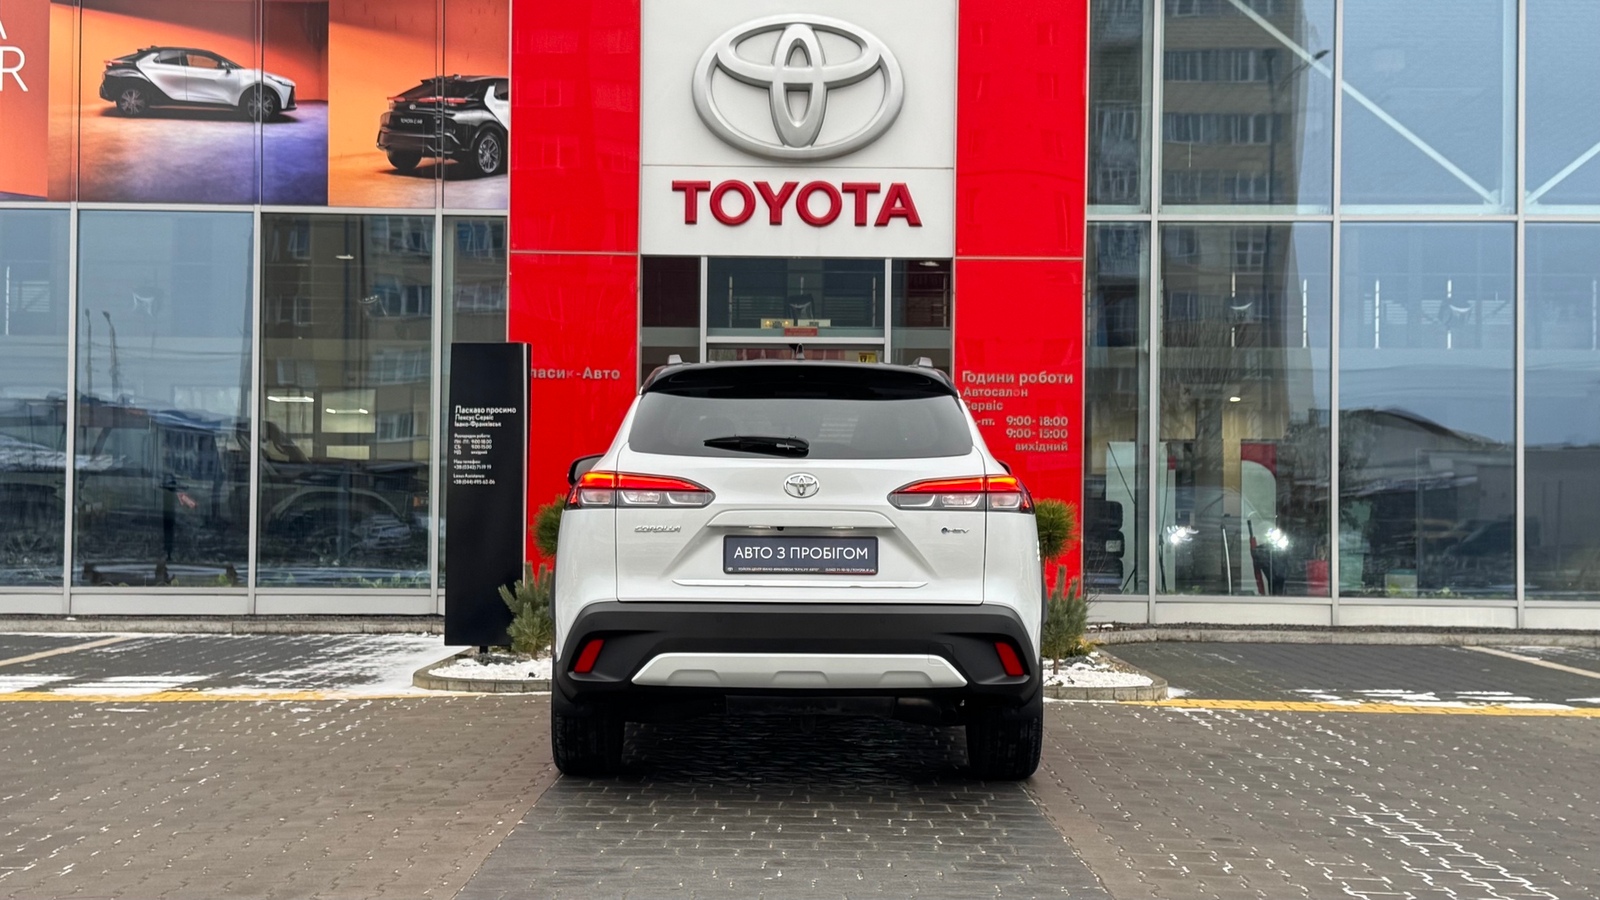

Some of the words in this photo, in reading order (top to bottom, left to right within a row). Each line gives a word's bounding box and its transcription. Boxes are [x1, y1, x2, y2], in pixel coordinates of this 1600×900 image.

[672, 180, 922, 227] TOYOTA
[962, 371, 1014, 384] Години
[1019, 371, 1073, 386] роботи
[963, 387, 1028, 397] Автосалон
[1015, 441, 1068, 451] вихідний
[734, 546, 773, 559] АВТО
[776, 546, 786, 559] З
[790, 547, 868, 560] ПРОБІГОМ
